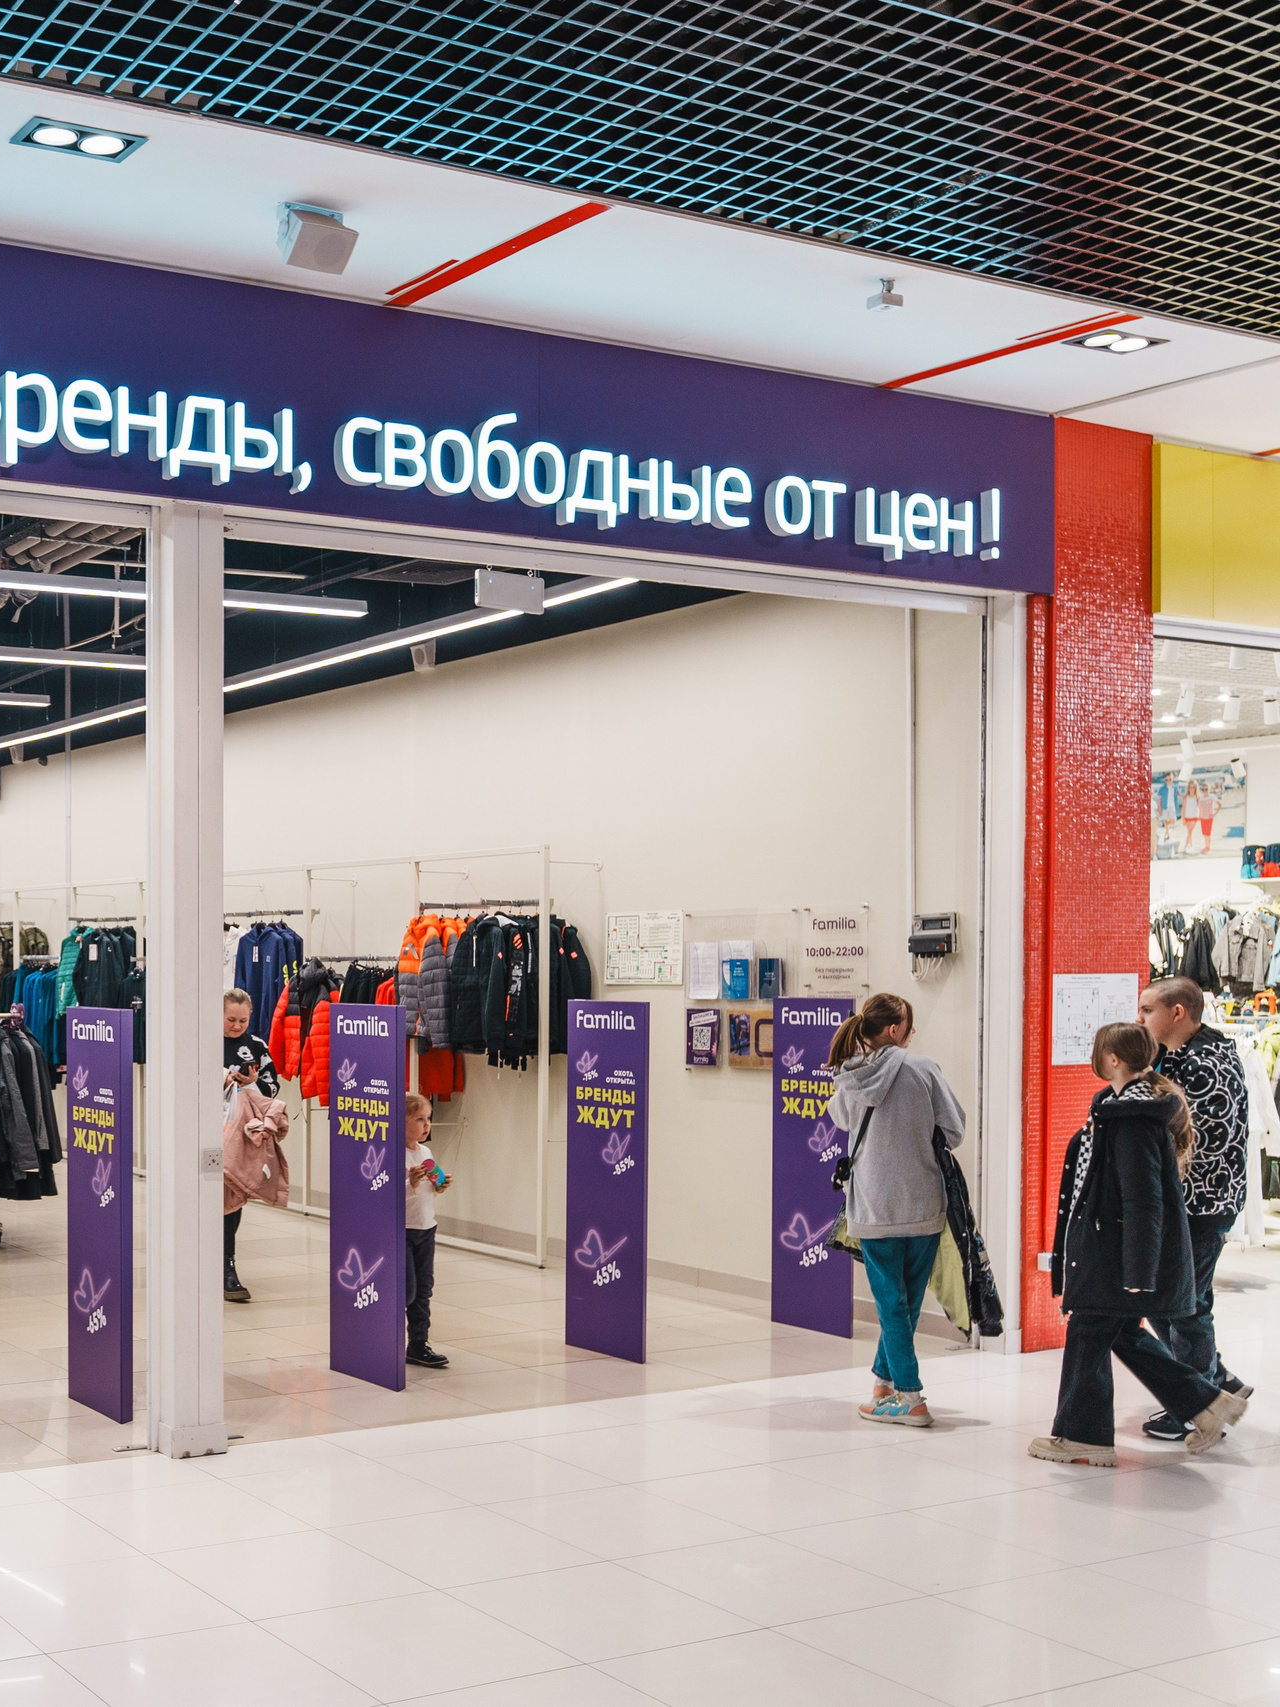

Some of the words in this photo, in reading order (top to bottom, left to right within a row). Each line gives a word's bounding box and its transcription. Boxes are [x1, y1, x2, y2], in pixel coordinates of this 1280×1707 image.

[333, 412, 753, 530] свободные
[765, 474, 847, 540] от
[855, 487, 1000, 561] цен!
[812, 917, 856, 930] familia
[805, 946, 864, 957] 10:00-22:00
[336, 1014, 389, 1038] familia
[576, 1009, 636, 1031] familia
[781, 1006, 843, 1027] familia
[72, 1018, 115, 1043] familia
[582, 1069, 599, 1082] -75%
[613, 1069, 634, 1078] ОХОТА
[787, 1062, 805, 1075] -75%
[342, 1077, 358, 1091] -75%
[363, 1086, 390, 1096] ОТКРЫТА!
[605, 1077, 636, 1086] ОТКРЫТА!
[336, 1096, 390, 1117] БРЕНДЫ
[575, 1086, 636, 1106] БРЕНДЫ
[72, 1105, 115, 1129] БРЕНДЫ
[576, 1105, 635, 1129] ЖДУТ
[781, 1096, 829, 1120] ЖДУ
[73, 1126, 115, 1155] ЖДУТ
[337, 1116, 389, 1143] ЖДУТ
[819, 1142, 842, 1162] -85%
[612, 1154, 635, 1177] -85%
[370, 1169, 390, 1192] -85%
[799, 1242, 829, 1268] -65%
[593, 1260, 621, 1287] -65%
[353, 1281, 379, 1310] -65%
[86, 1305, 107, 1334] -65%
